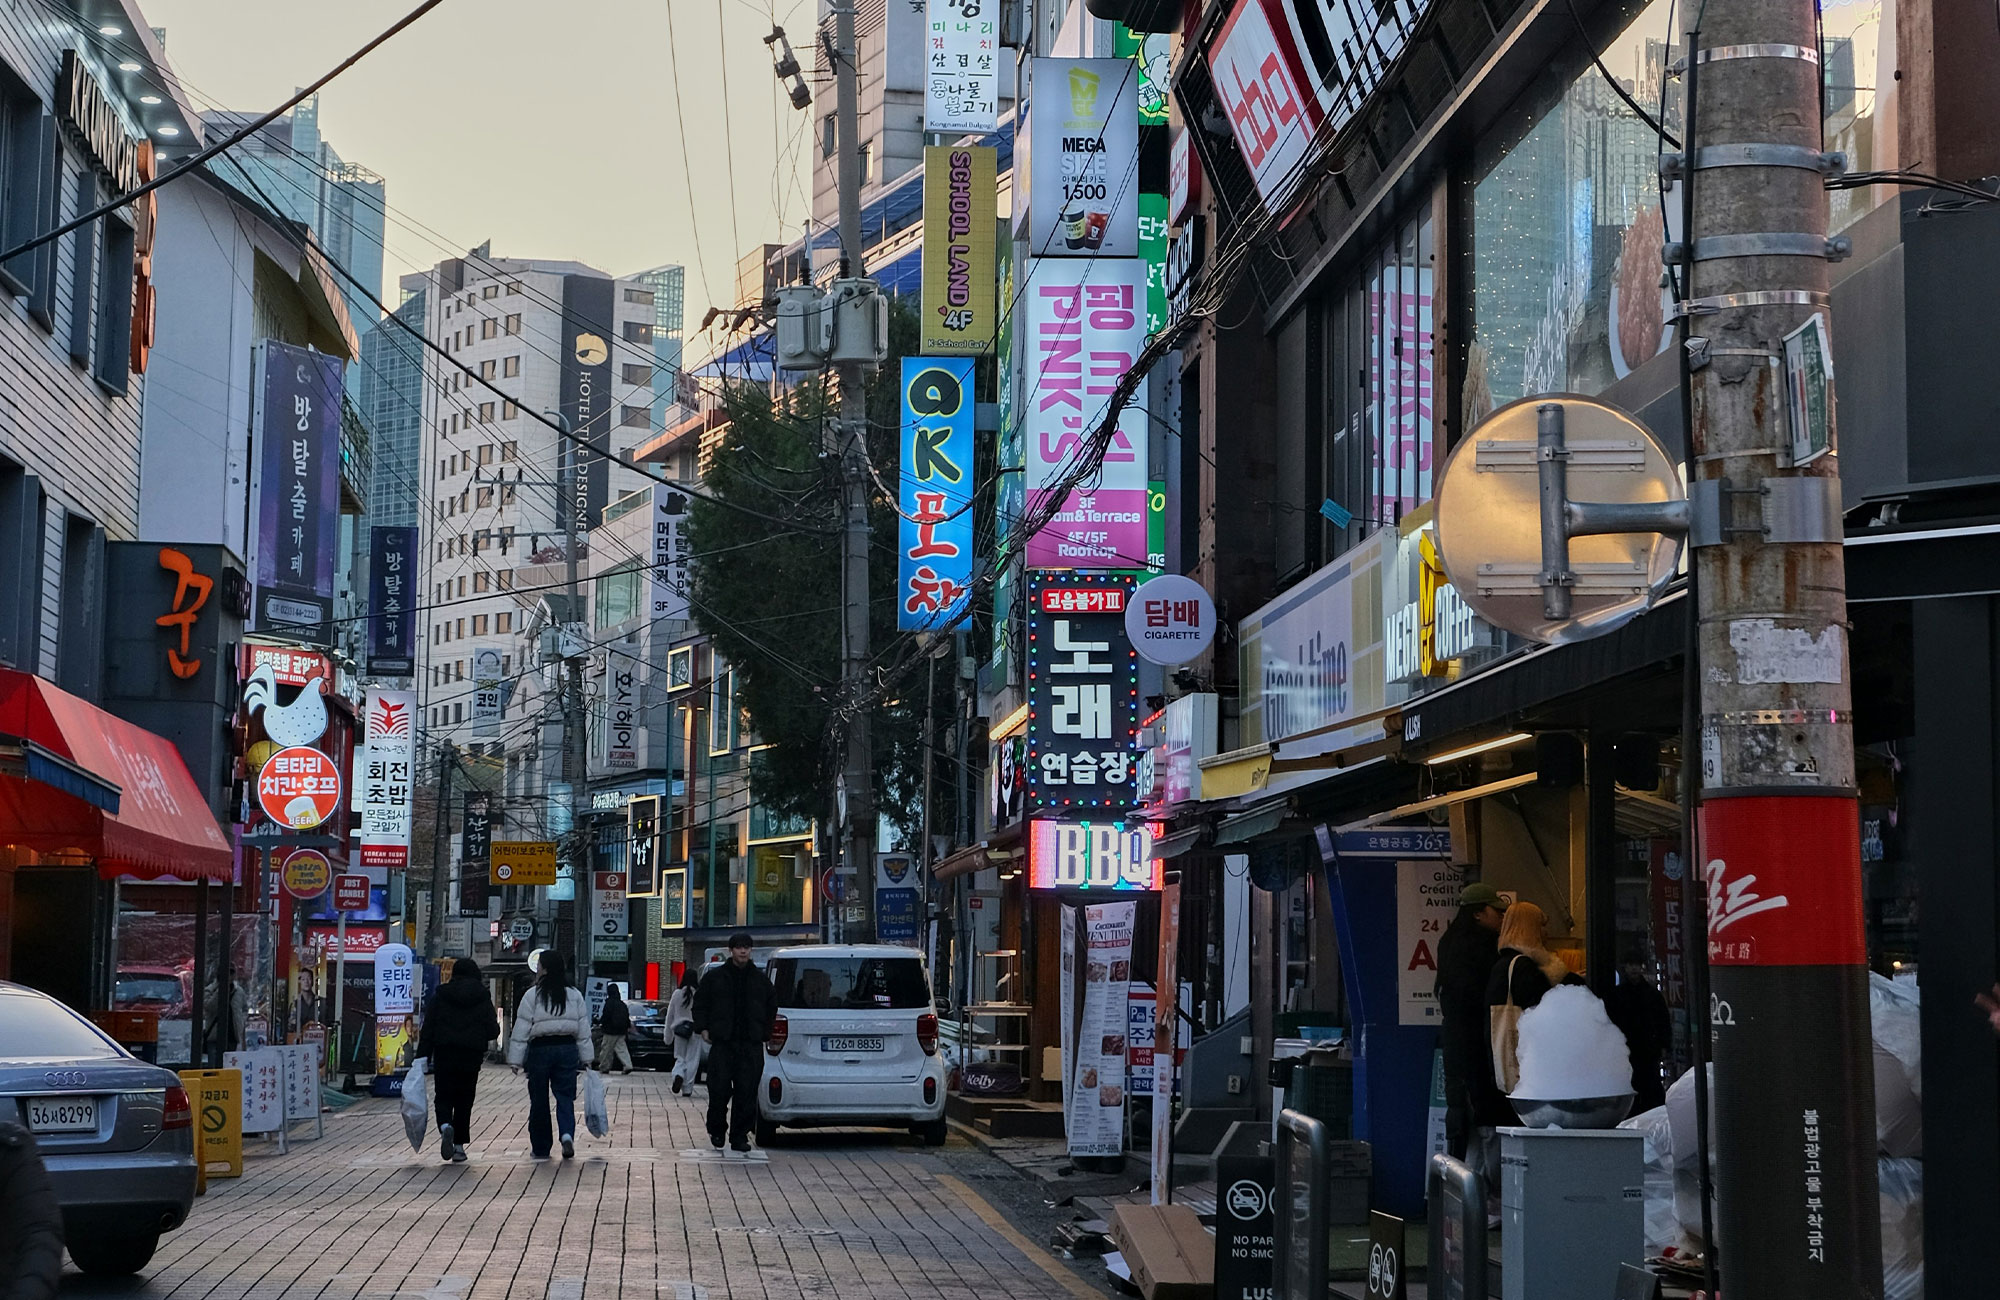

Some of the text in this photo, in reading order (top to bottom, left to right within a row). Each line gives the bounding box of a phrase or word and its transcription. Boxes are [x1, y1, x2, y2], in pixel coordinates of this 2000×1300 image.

[932, 21, 993, 34] 미나리
[932, 36, 992, 49] 김치
[931, 53, 992, 69] 삼겹살
[931, 79, 981, 99] 콩나물
[945, 96, 993, 116] 불고기
[1219, 50, 1313, 170] bbq
[930, 120, 993, 130] Kongnamul Bulgogi
[1062, 137, 1106, 153] MEGA
[1060, 154, 1107, 175] SIZE
[946, 150, 972, 307] SCHOOL LAND
[942, 309, 973, 331] 4F
[1039, 284, 1083, 464] PINK'S
[577, 370, 591, 422] HOTEL
[291, 394, 312, 578] 방탈출 카페
[1079, 496, 1096, 509] 3F
[1034, 508, 1140, 523] oom&Terrace
[1067, 531, 1108, 542] 4F/5F
[657, 521, 670, 583] 머더파커
[1058, 543, 1117, 559] Rooftop
[655, 601, 669, 612] 3F
[1046, 590, 1104, 611] 고음불가
[156, 547, 214, 679] 꾼
[1144, 599, 1200, 627] 담배
[1144, 630, 1201, 641] CIGARETTE
[1386, 601, 1420, 684] MEGA
[1050, 619, 1113, 739] 노래
[476, 693, 498, 708] 코인
[1404, 714, 1421, 741] LUSH
[275, 757, 322, 774] 로타리
[367, 761, 408, 783] 회전
[1041, 751, 1130, 786] 연습장
[366, 784, 408, 806] 초밥
[288, 816, 312, 825] BEER
[366, 809, 407, 821] 모든접시
[370, 821, 401, 833] 균일가
[1367, 833, 1445, 851] 은행공동 365
[494, 846, 554, 856] 어린이보호구역
[1056, 823, 1152, 888] BBQ
[499, 868, 510, 876] 30
[1419, 884, 1454, 895] Credit
[600, 902, 625, 912] 주차장
[1420, 919, 1440, 932] 24
[966, 1073, 997, 1090] Kelly
[1803, 1109, 1825, 1263] 불법광고물 부착금지
[1233, 1235, 1249, 1246] NO
[1231, 1248, 1249, 1259] NO
